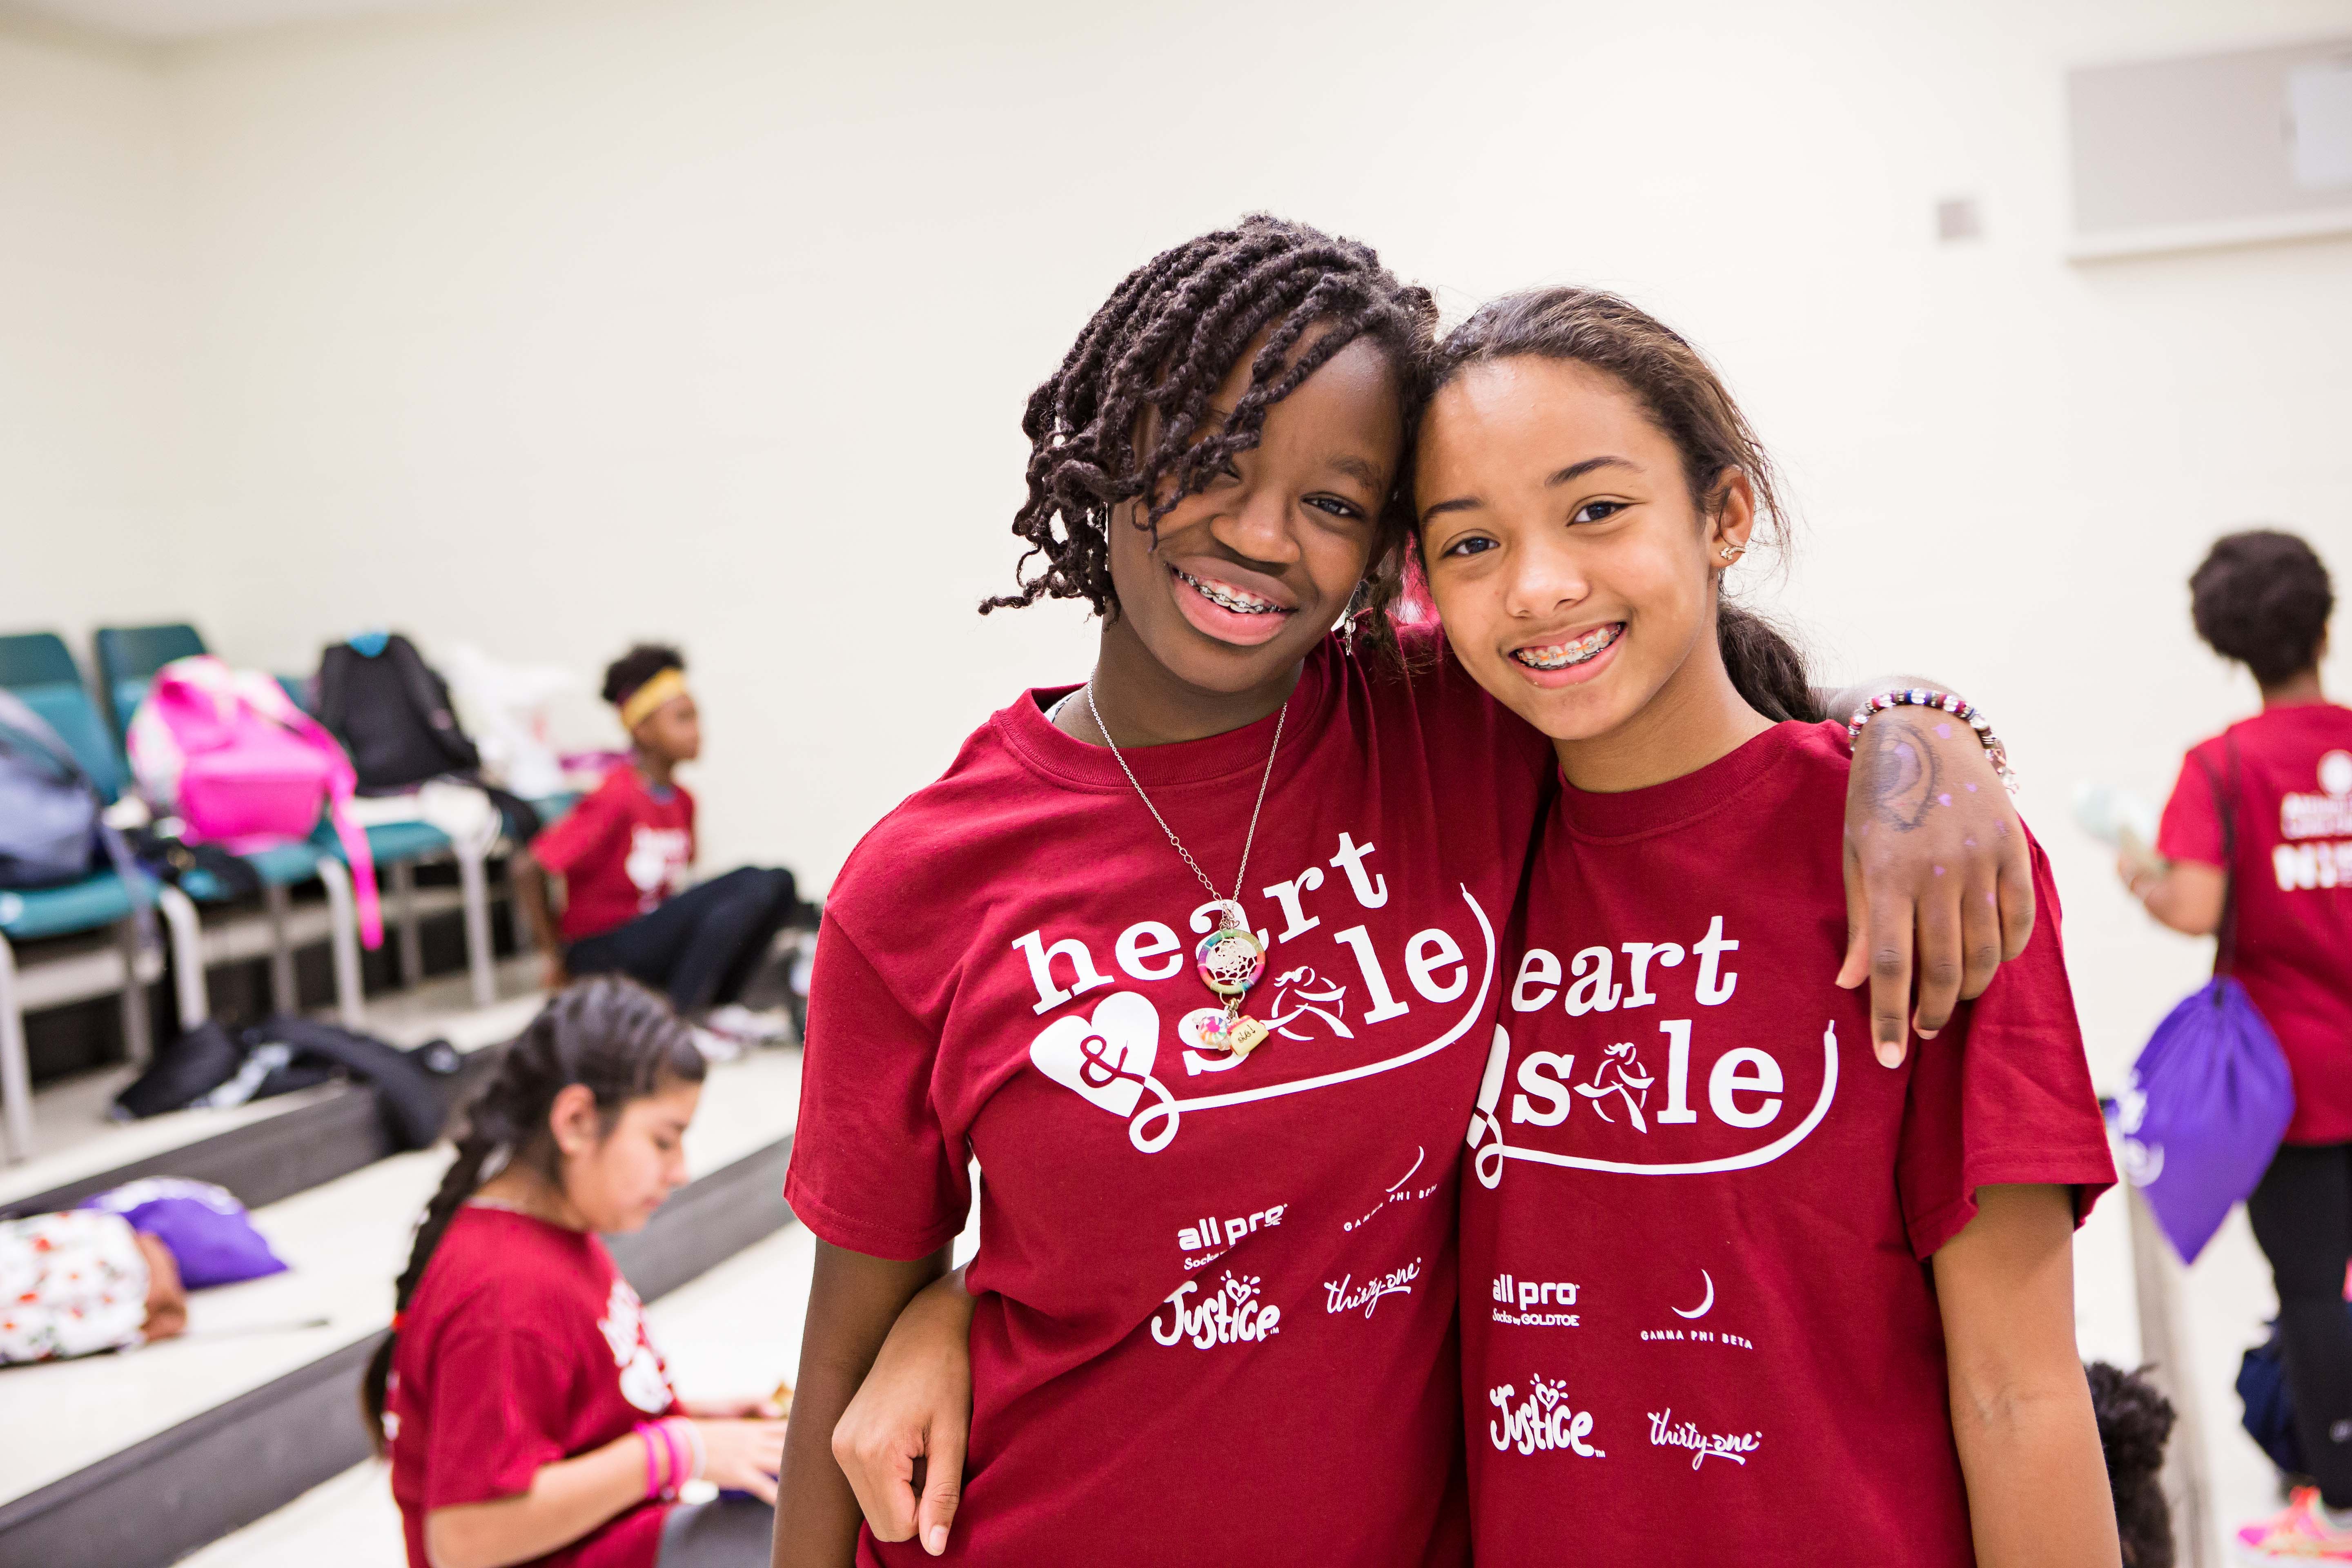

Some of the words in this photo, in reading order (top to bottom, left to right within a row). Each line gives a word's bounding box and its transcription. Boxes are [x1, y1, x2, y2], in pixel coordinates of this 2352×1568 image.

[1511, 915, 1740, 1016] eart
[1389, 1191, 1410, 1203] PHI
[1178, 1216, 1221, 1251] all
[1224, 1205, 1284, 1246] pro
[1151, 1279, 1281, 1350] Justice
[1492, 1273, 1514, 1303] all
[1518, 1282, 1577, 1311] pro
[1492, 1307, 1512, 1324] Socks
[1521, 1313, 1580, 1326] GOLDTOE
[1640, 1330, 1684, 1341] GAMMA
[1690, 1330, 1714, 1342] PHI
[1721, 1333, 1753, 1350] BETA
[1490, 1383, 1595, 1457] Justice
[1647, 1408, 1760, 1470] thirty-one
